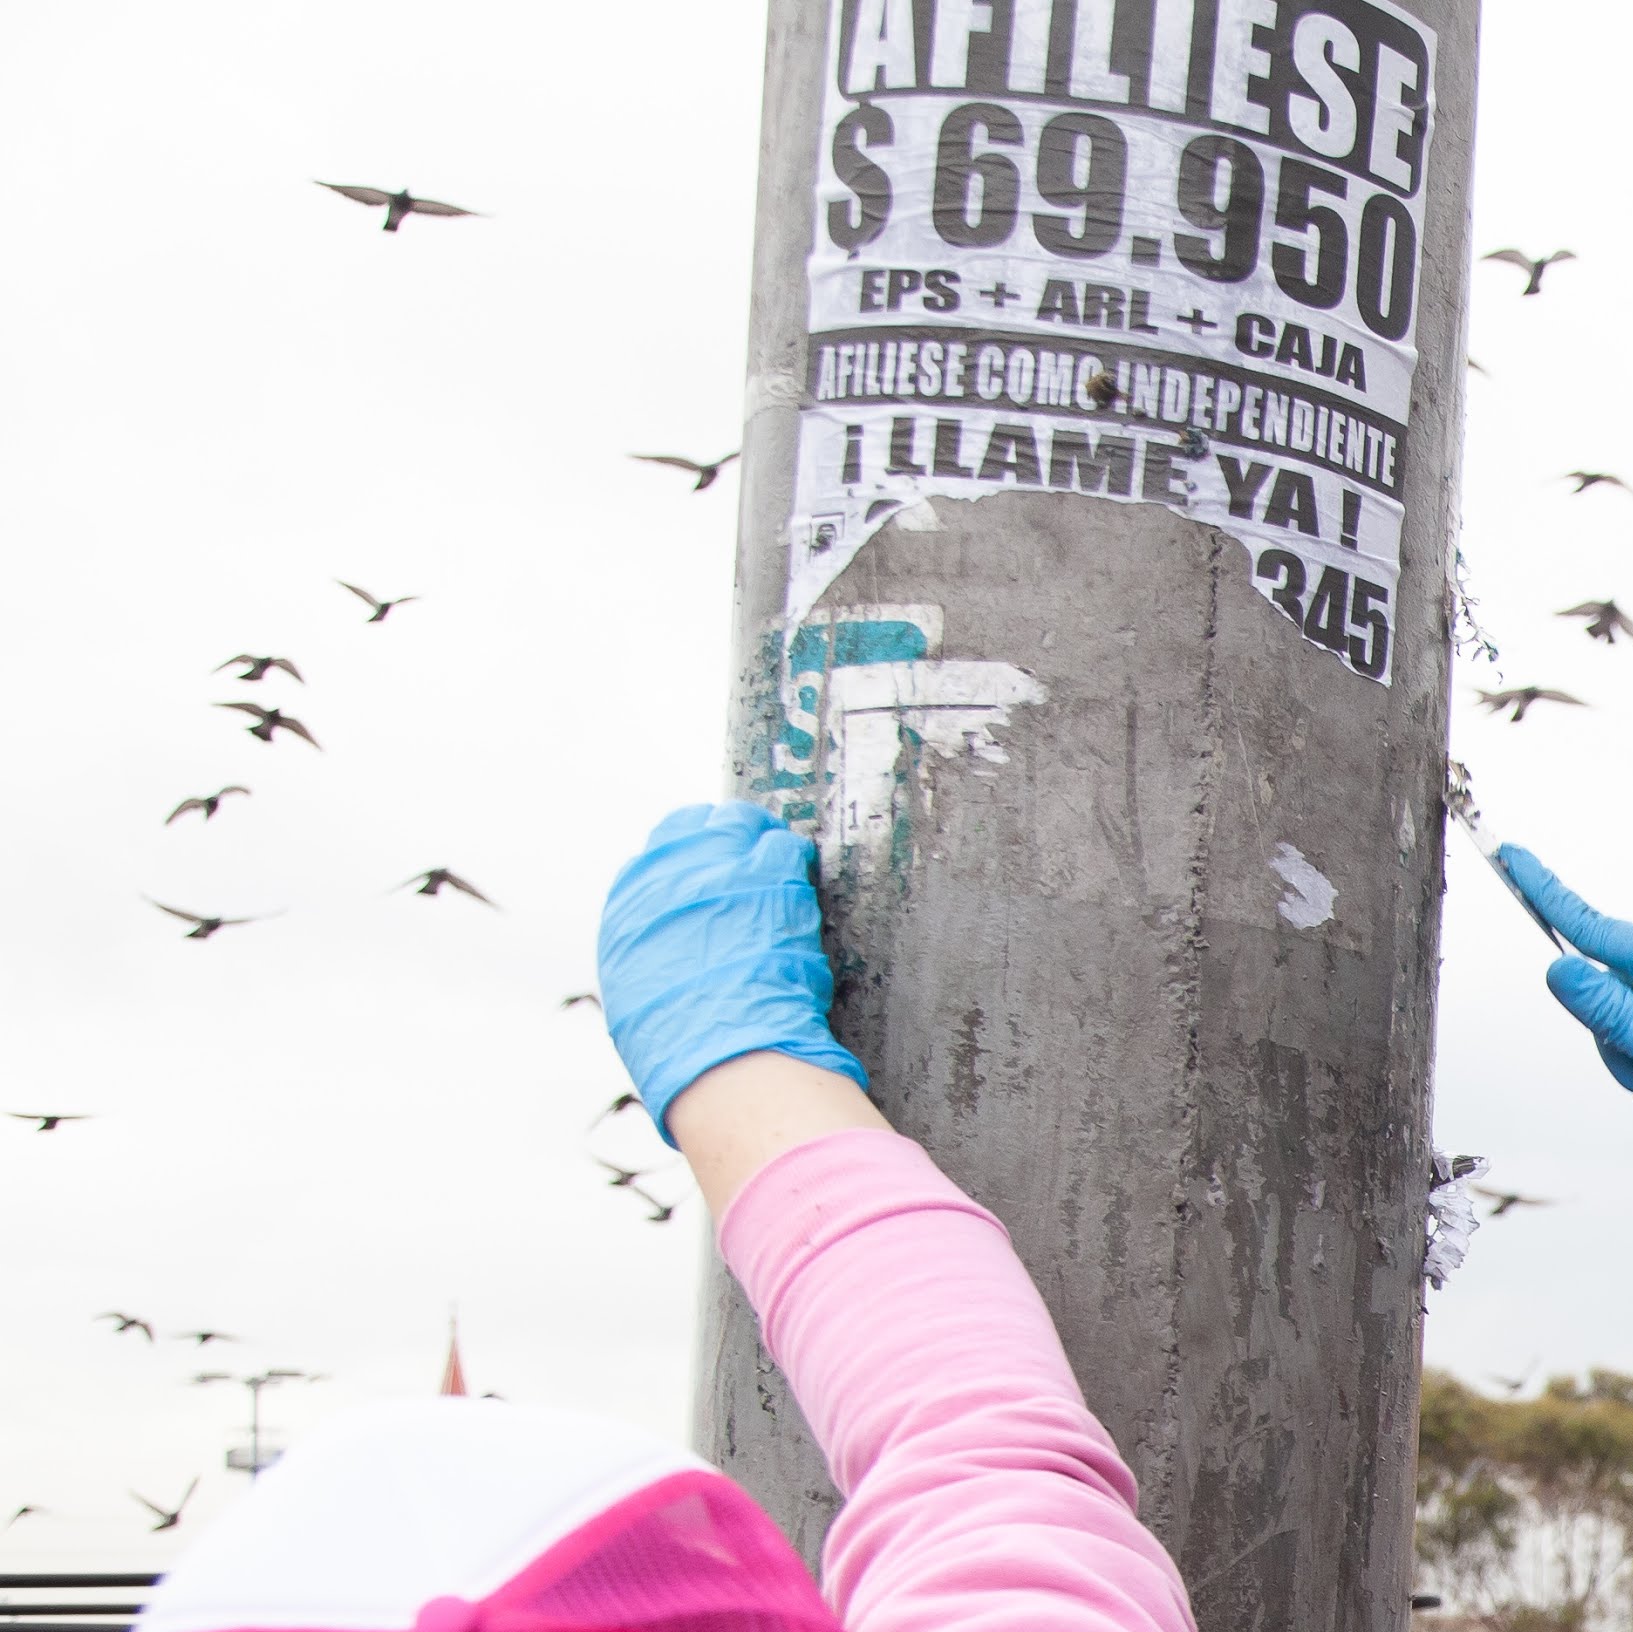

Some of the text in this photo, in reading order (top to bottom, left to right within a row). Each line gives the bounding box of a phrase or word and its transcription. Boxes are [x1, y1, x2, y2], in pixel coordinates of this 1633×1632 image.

[845, 0, 1420, 193] AFILIESE
[931, 102, 1417, 342] 69.950
[817, 340, 1397, 489] AFILIESE COMO INDEPENDIENTE
[858, 268, 962, 314] EPS
[1036, 279, 1159, 336] ARL
[1235, 312, 1368, 394] CAJA
